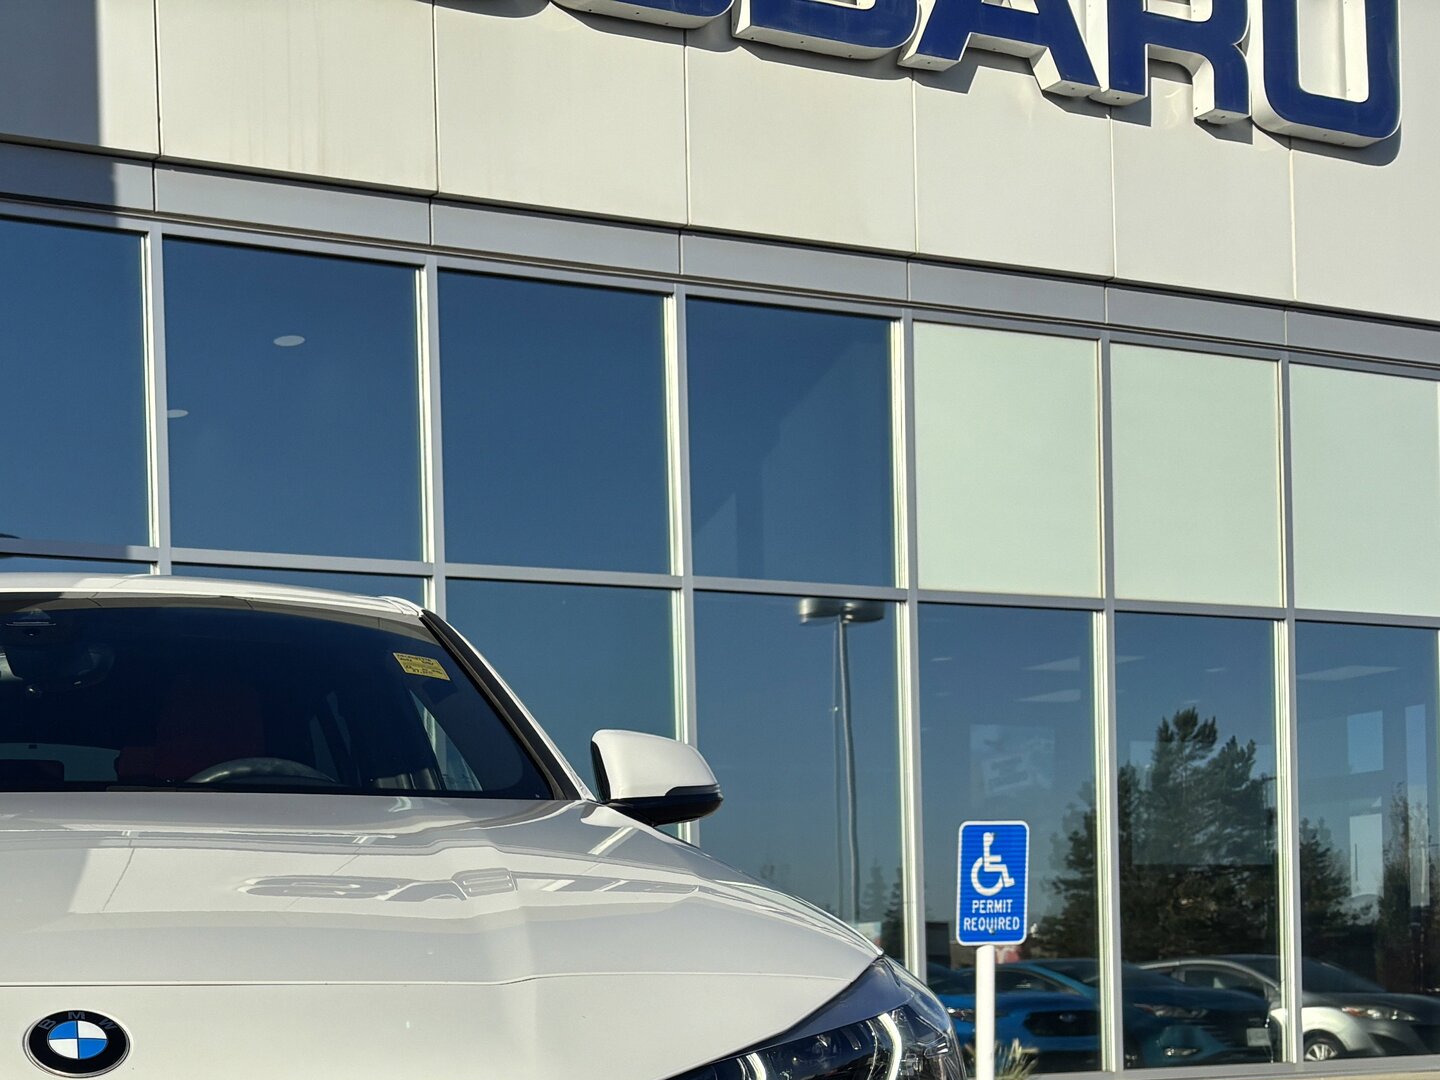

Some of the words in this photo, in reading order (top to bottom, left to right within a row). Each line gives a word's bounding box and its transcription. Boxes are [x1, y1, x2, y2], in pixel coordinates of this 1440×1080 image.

[971, 899, 1014, 914] PERMIT
[963, 916, 1020, 932] REQUIRED
[37, 1011, 117, 1030] BMW
